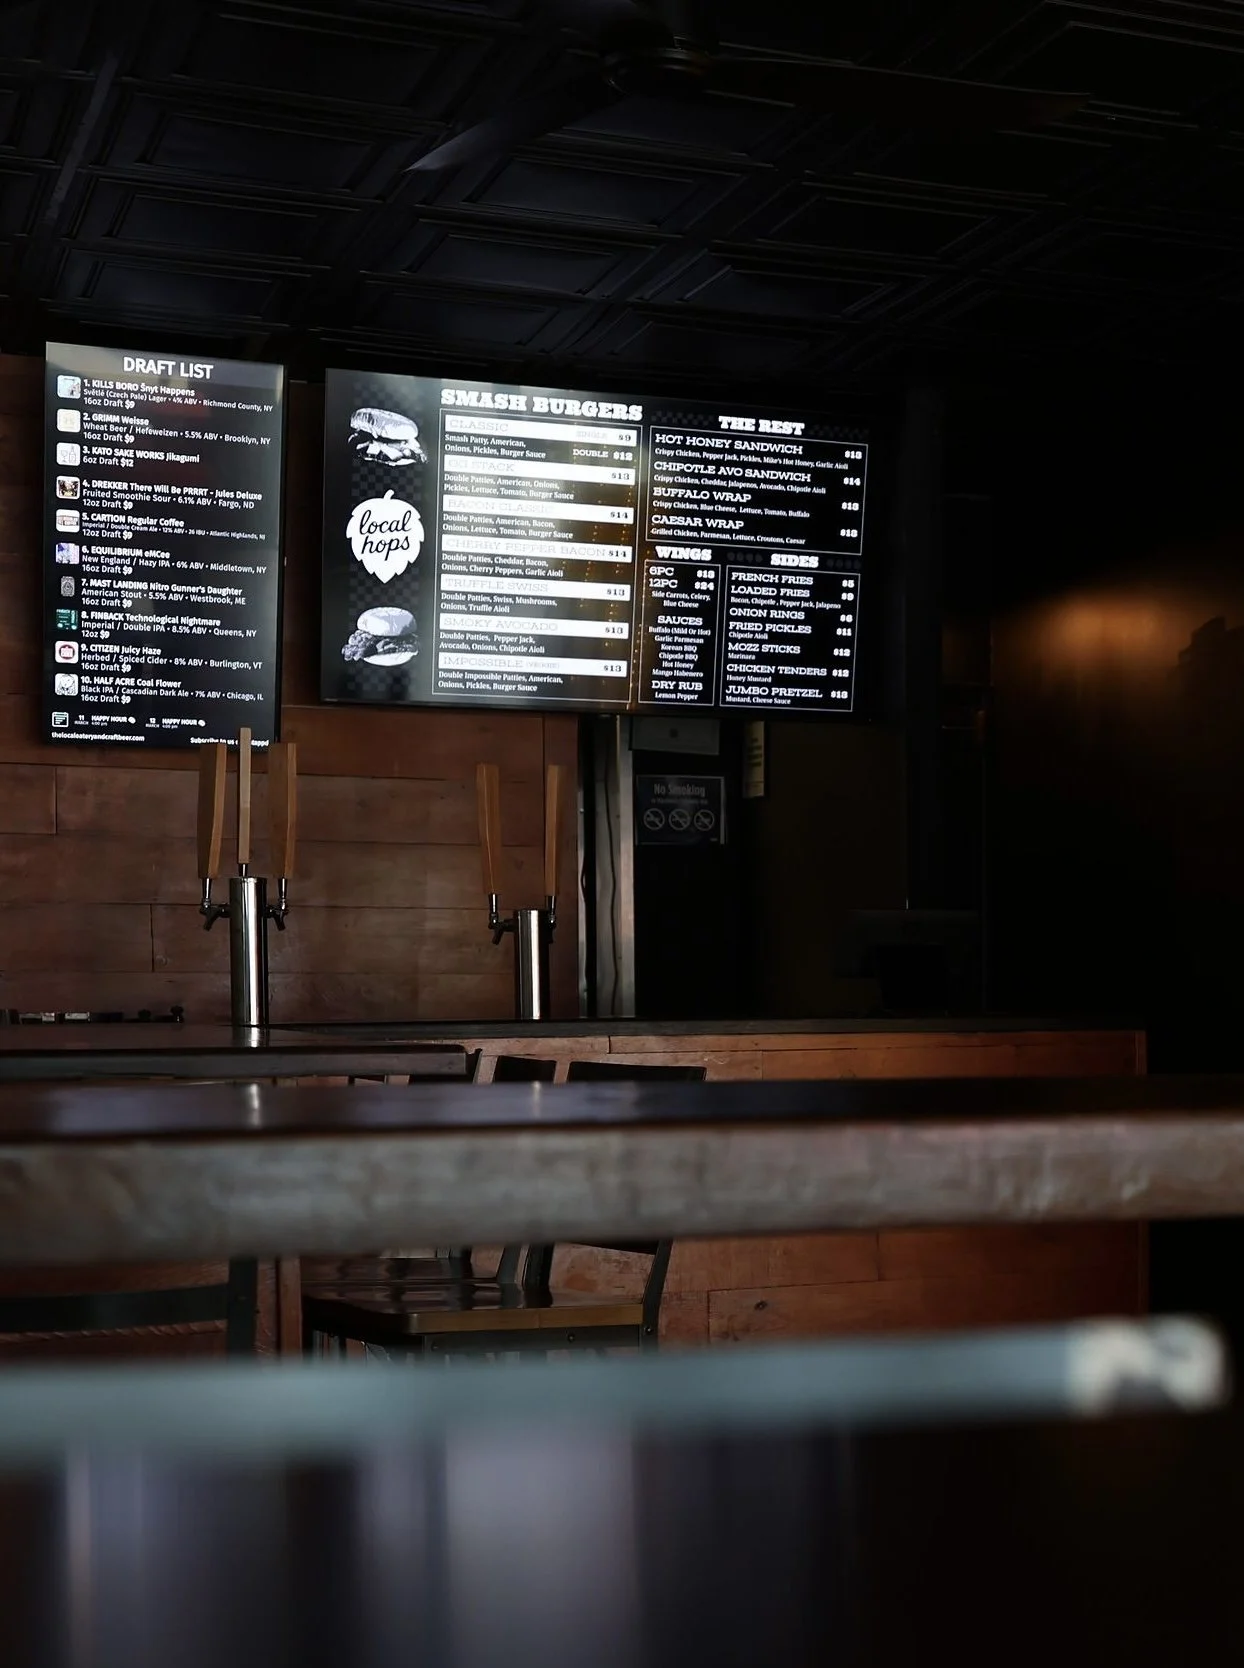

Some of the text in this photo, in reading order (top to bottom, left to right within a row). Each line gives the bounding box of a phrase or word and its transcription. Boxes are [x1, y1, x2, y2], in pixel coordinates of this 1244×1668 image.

[123, 357, 212, 378] DRAFT LIST
[84, 379, 89, 388] 1.
[92, 380, 113, 390] KILLS
[160, 385, 194, 396] Happens
[84, 397, 101, 407] 16oz
[103, 398, 122, 409] Draft
[125, 399, 134, 410] $9
[441, 389, 641, 421] SMASH BURGERS
[83, 413, 90, 422] 2.
[92, 413, 119, 424] GRIMM
[449, 418, 509, 432] CLASSIC
[718, 415, 804, 433] THE REST
[83, 422, 270, 446] Wheat Beer Hefeweizen 5.5% ABV Brooklyn, NY
[445, 434, 525, 448] Smash Patty, American,
[655, 434, 802, 453] HOT HONEY SANDWICH
[82, 446, 89, 455] 3.
[92, 447, 112, 457] KATO
[114, 448, 133, 458] SAKE
[135, 450, 164, 460] WORKS
[445, 444, 545, 459] Onions, Pickles, Burger Sauce
[573, 448, 608, 458] DOUBLE
[83, 456, 96, 465] 6oz
[99, 457, 118, 467] Draft
[654, 461, 715, 474] CHIPOTLE
[718, 466, 742, 476] AVO
[745, 468, 810, 480] SANDWICH
[82, 479, 89, 489] 4.
[92, 480, 127, 492] DREKKER
[129, 482, 151, 493] There
[153, 484, 168, 494] Will
[171, 485, 180, 495] Be
[215, 488, 233, 499] Jules
[236, 490, 261, 500] Deluxe
[653, 487, 750, 500] BUFFALO WRAP
[83, 489, 254, 509] Fruited Smoothie Sour 6.1% ABV Fargo, ND
[82, 512, 89, 522] 5.
[127, 515, 157, 526] Regular
[159, 517, 183, 528] Coffee
[360, 510, 412, 535] local
[652, 515, 743, 530] CAESAR WRAP
[82, 545, 88, 555] 6.
[91, 546, 142, 558] EQUILIBRIUM
[361, 535, 410, 561] hops
[655, 545, 712, 561] WINGS
[770, 553, 819, 568] SIDES
[649, 566, 674, 576] 6PC
[445, 577, 504, 590] TRUFFLE
[507, 582, 549, 592] SWISS
[649, 578, 678, 588] 12PC
[731, 572, 778, 583] FRENCH
[781, 575, 812, 585] FRIES
[81, 578, 241, 595] 7. MAST LANDING Nitro Gunner's Daughter
[731, 585, 776, 596] LOADED
[780, 588, 809, 597] FRIES
[81, 611, 220, 626] 8. FINBACK Technological Nightmare
[657, 615, 703, 625] SAUCES
[729, 608, 767, 618] ONION
[770, 610, 804, 620] RINGS
[444, 618, 558, 631] SMOKY AVOCADO
[729, 622, 762, 631] FRIED
[765, 623, 811, 634] PICKLES
[81, 644, 88, 652] 9.
[90, 644, 119, 654] CITIZEN
[121, 645, 140, 655] Juicy
[728, 642, 759, 652] MOZZ
[761, 644, 799, 654] STICKS
[444, 656, 523, 669] IMPOSSIBLE
[727, 664, 826, 676] CHICKEN TENDERS
[81, 676, 180, 688] 10. HALF ACRE Coal Flower
[652, 681, 702, 691] DRY RUB
[726, 685, 822, 698] JUMBO PRETZEL
[653, 783, 706, 798] No Smoking
